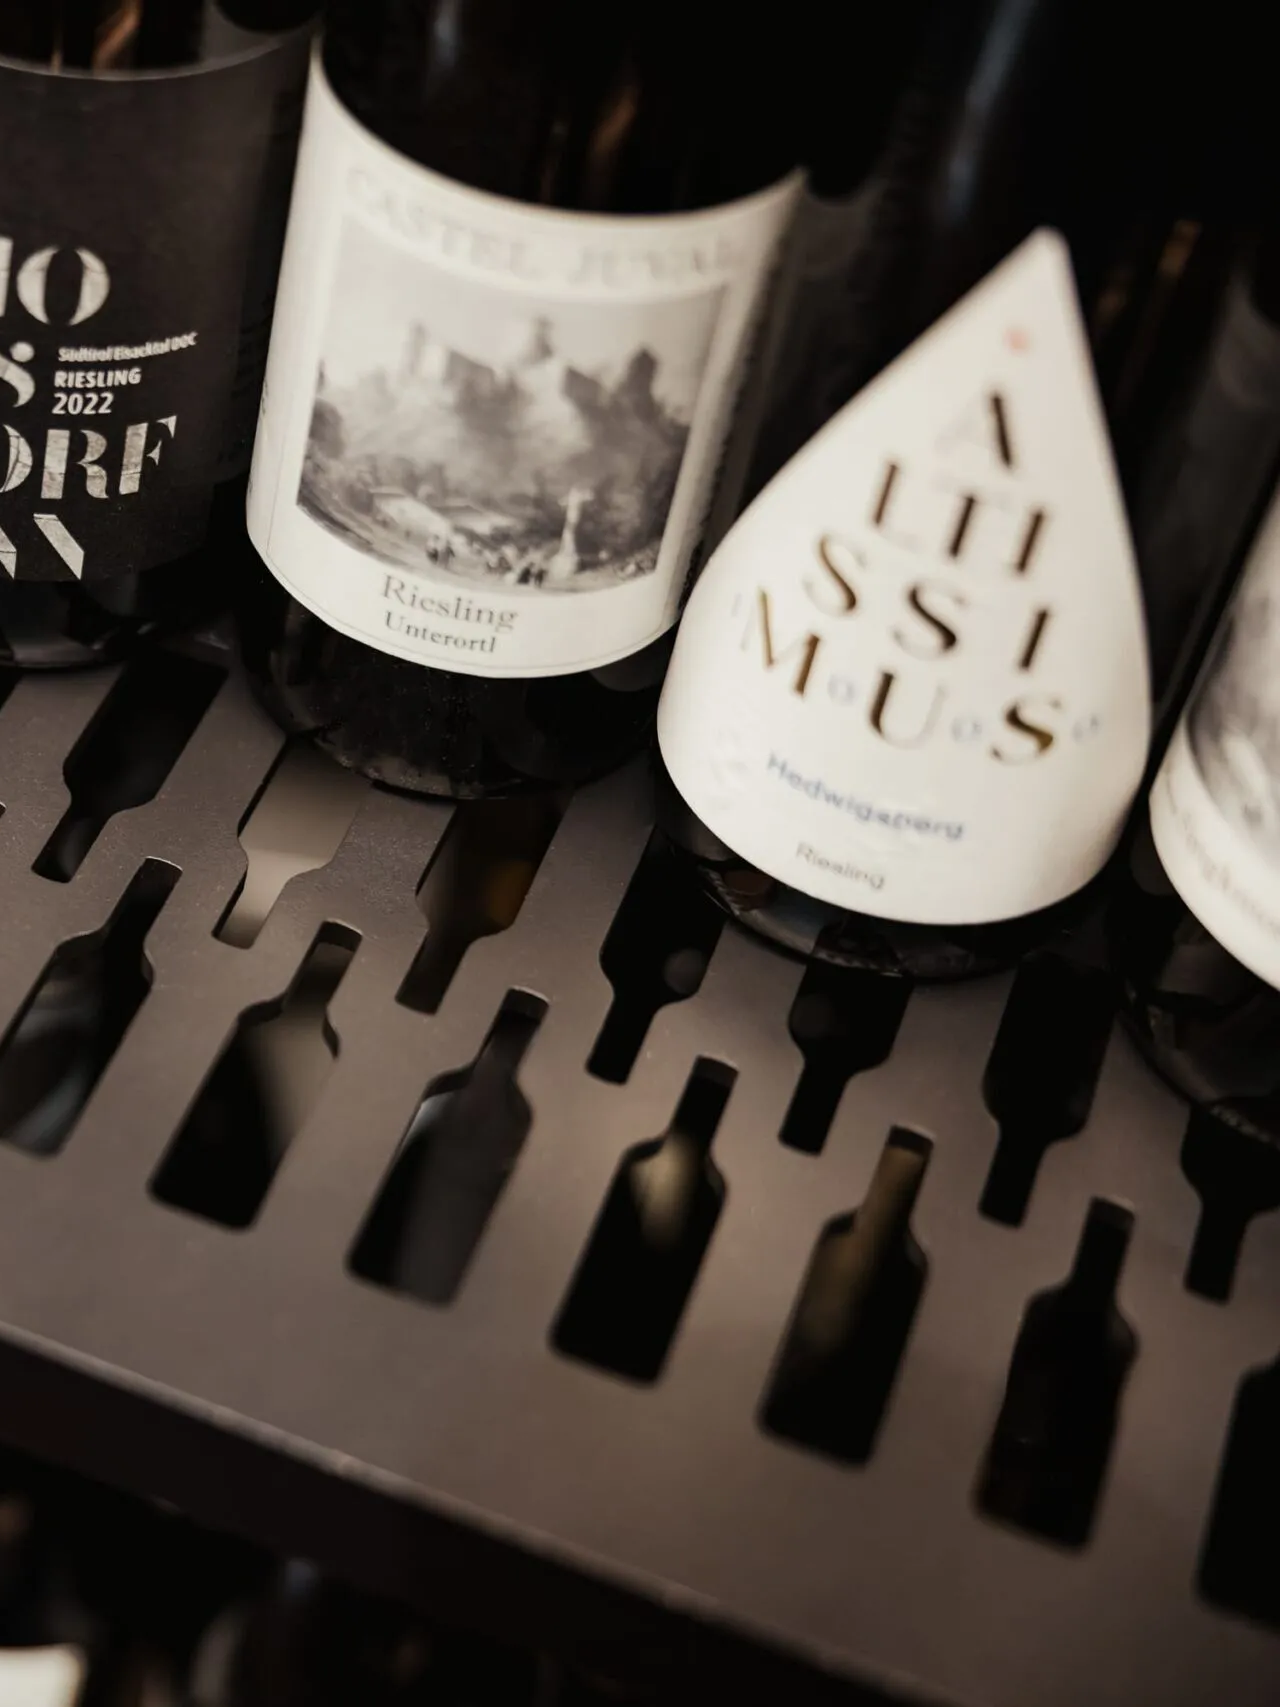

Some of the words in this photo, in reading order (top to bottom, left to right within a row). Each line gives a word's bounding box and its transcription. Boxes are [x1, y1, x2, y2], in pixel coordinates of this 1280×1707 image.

[54, 367, 142, 388] RIESLING
[52, 392, 114, 415] 2022
[382, 573, 518, 632] Riesling
[385, 610, 496, 653] Unterortl
